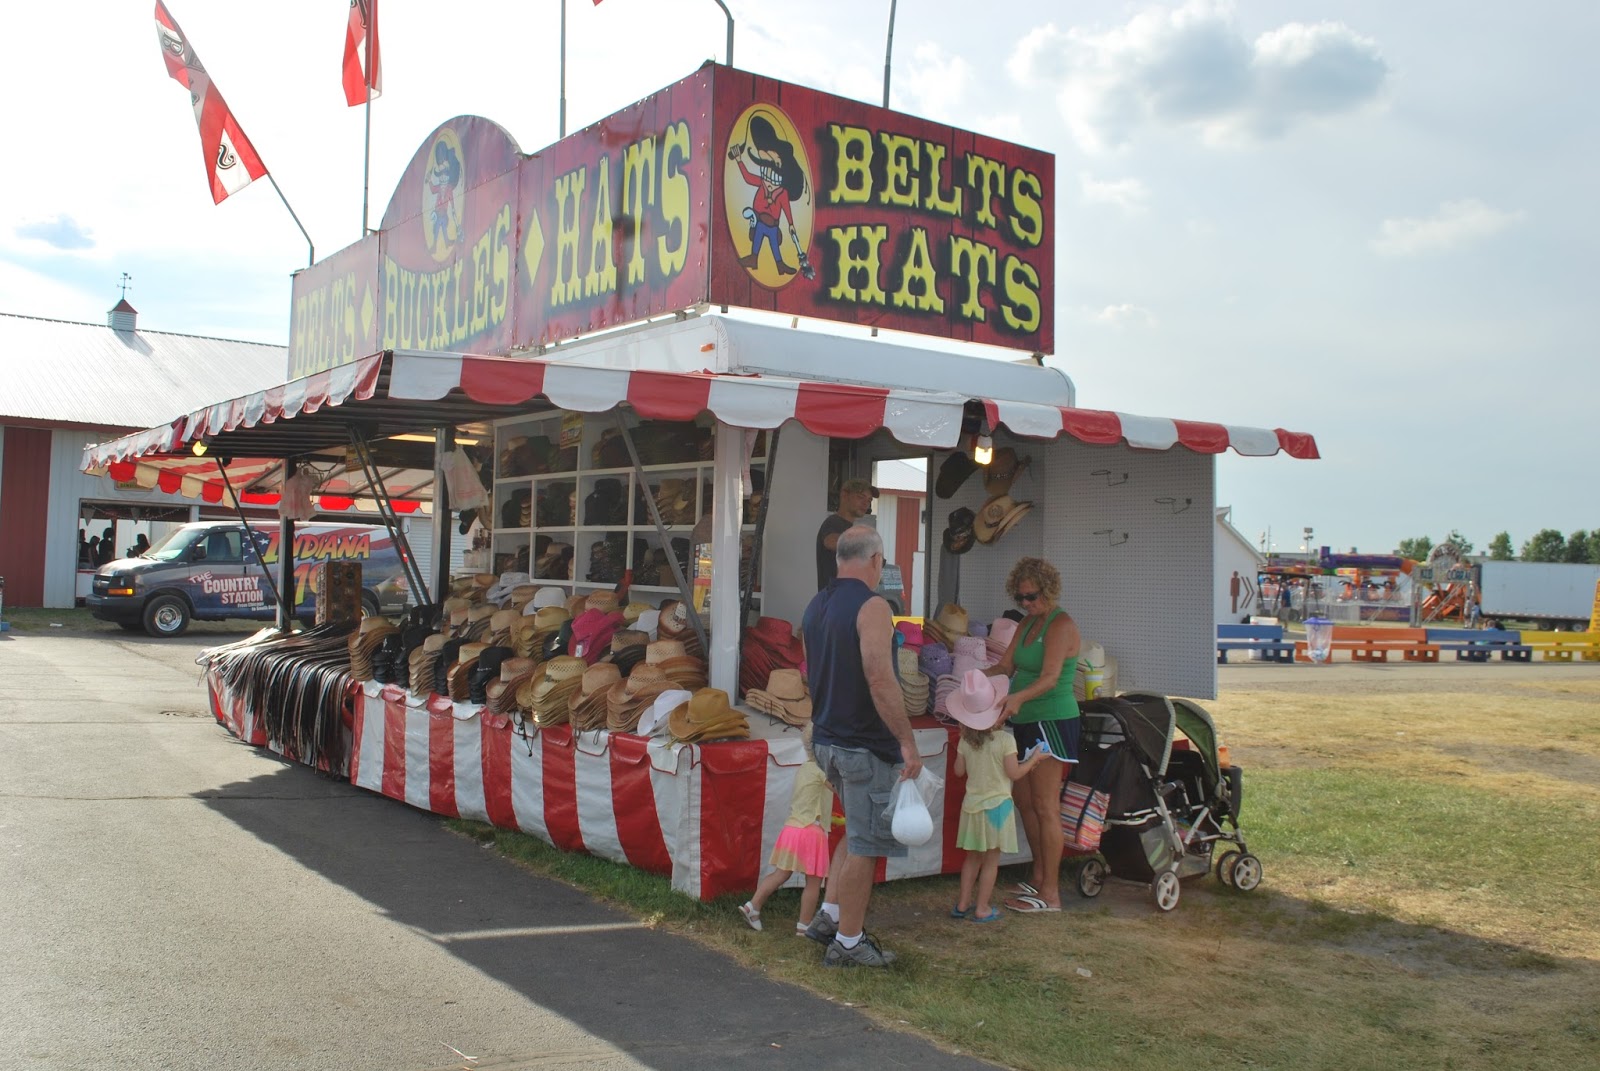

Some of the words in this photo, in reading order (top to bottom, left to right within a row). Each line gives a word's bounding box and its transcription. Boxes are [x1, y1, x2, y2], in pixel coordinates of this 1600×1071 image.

[829, 124, 1043, 248] BELTS
[293, 272, 356, 377] BELTS
[383, 205, 509, 350] BUCKLES
[551, 121, 692, 306] HATS
[829, 225, 1042, 333] HATS
[188, 571, 213, 583] THE
[203, 576, 259, 594] COUNTRY
[221, 590, 264, 604] STATION
